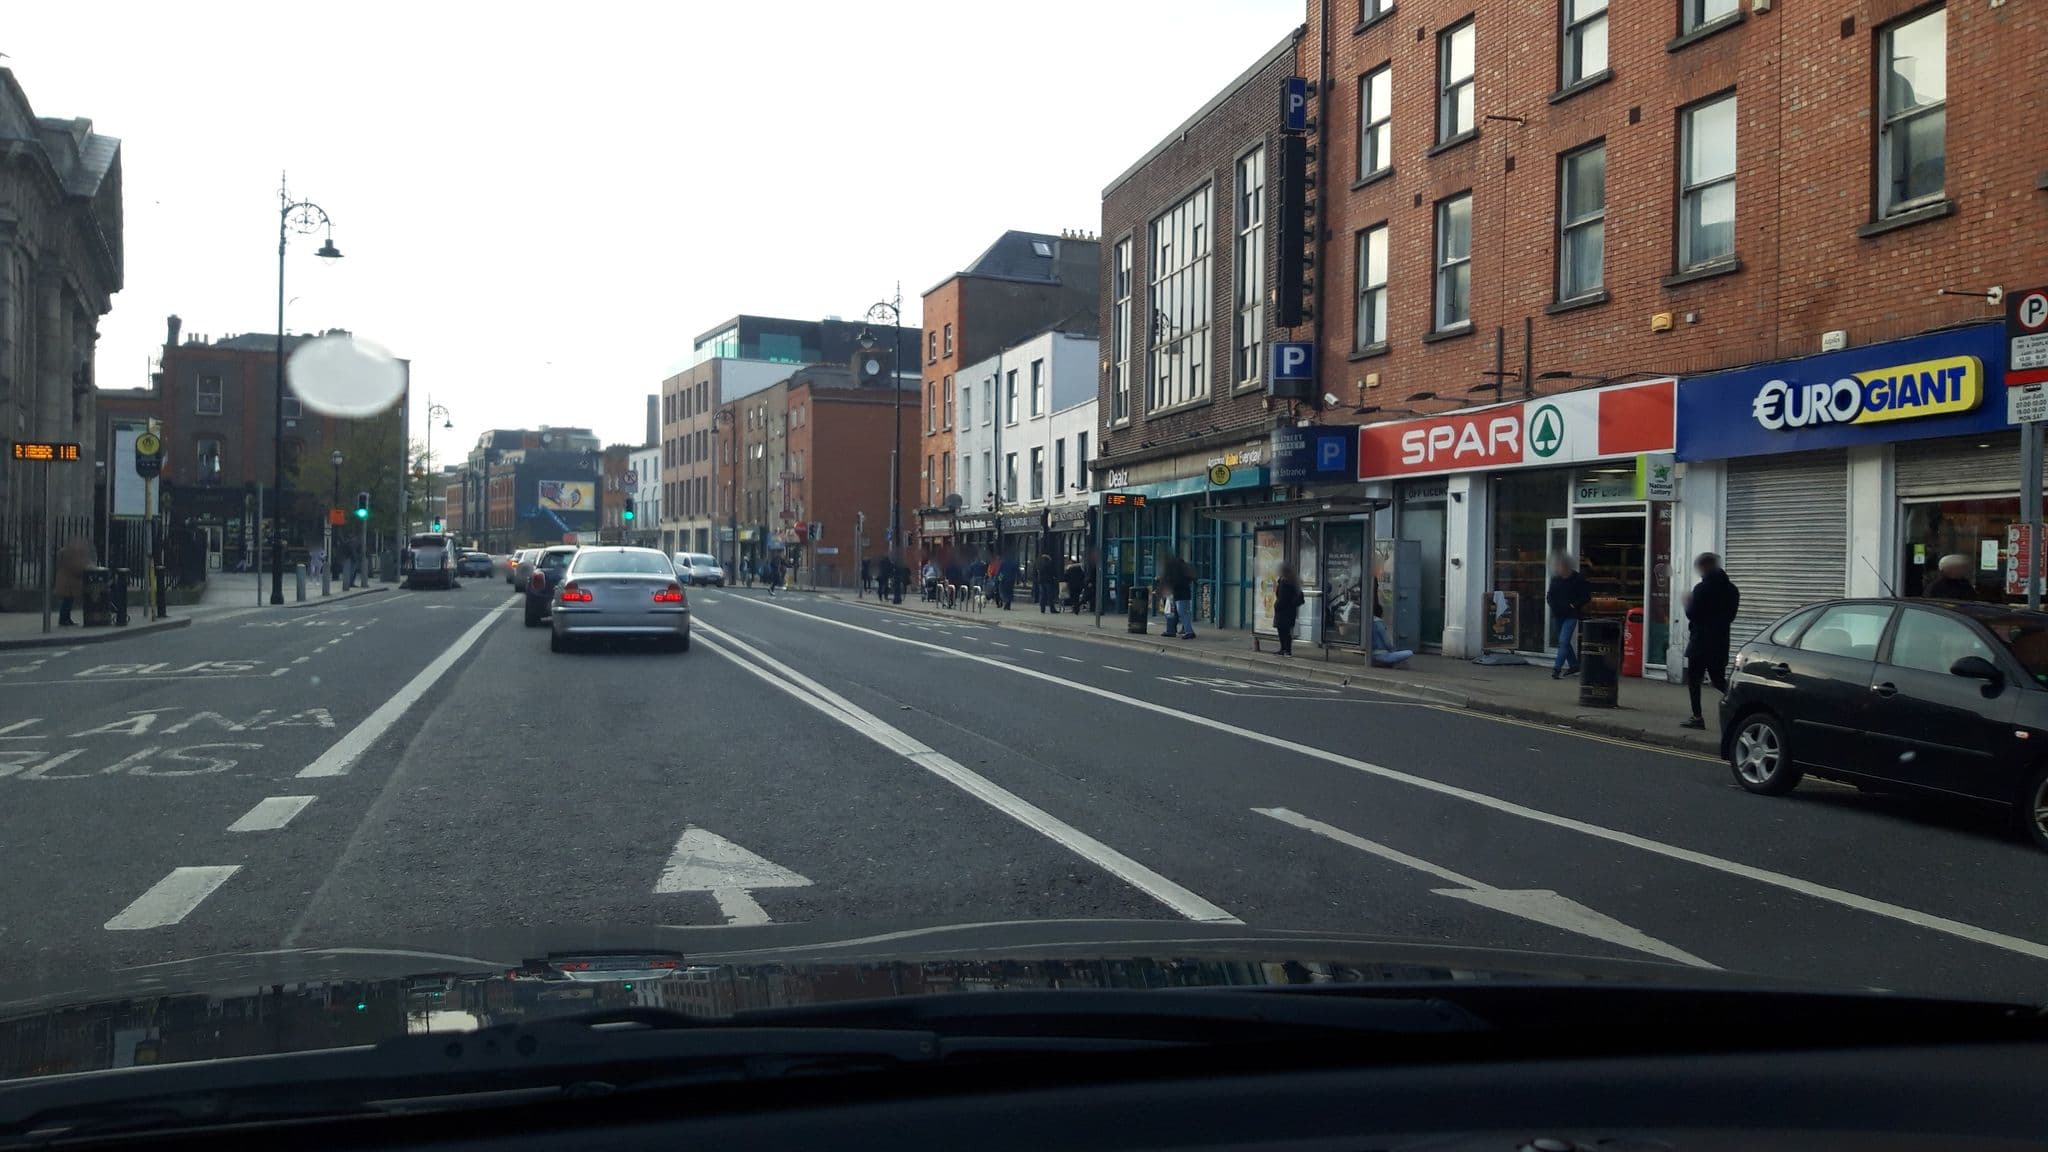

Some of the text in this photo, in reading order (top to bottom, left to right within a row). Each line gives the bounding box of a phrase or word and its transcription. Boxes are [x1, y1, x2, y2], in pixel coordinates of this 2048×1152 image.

[1290, 94, 1304, 113] P
[1283, 346, 1305, 375] P
[1402, 417, 1519, 465] SPAR
[1323, 443, 1340, 465] P
[1108, 469, 1128, 487] Dealz
[1649, 482, 1673, 490] National
[1581, 488, 1598, 498] OFF
[73, 660, 265, 676] BUS
